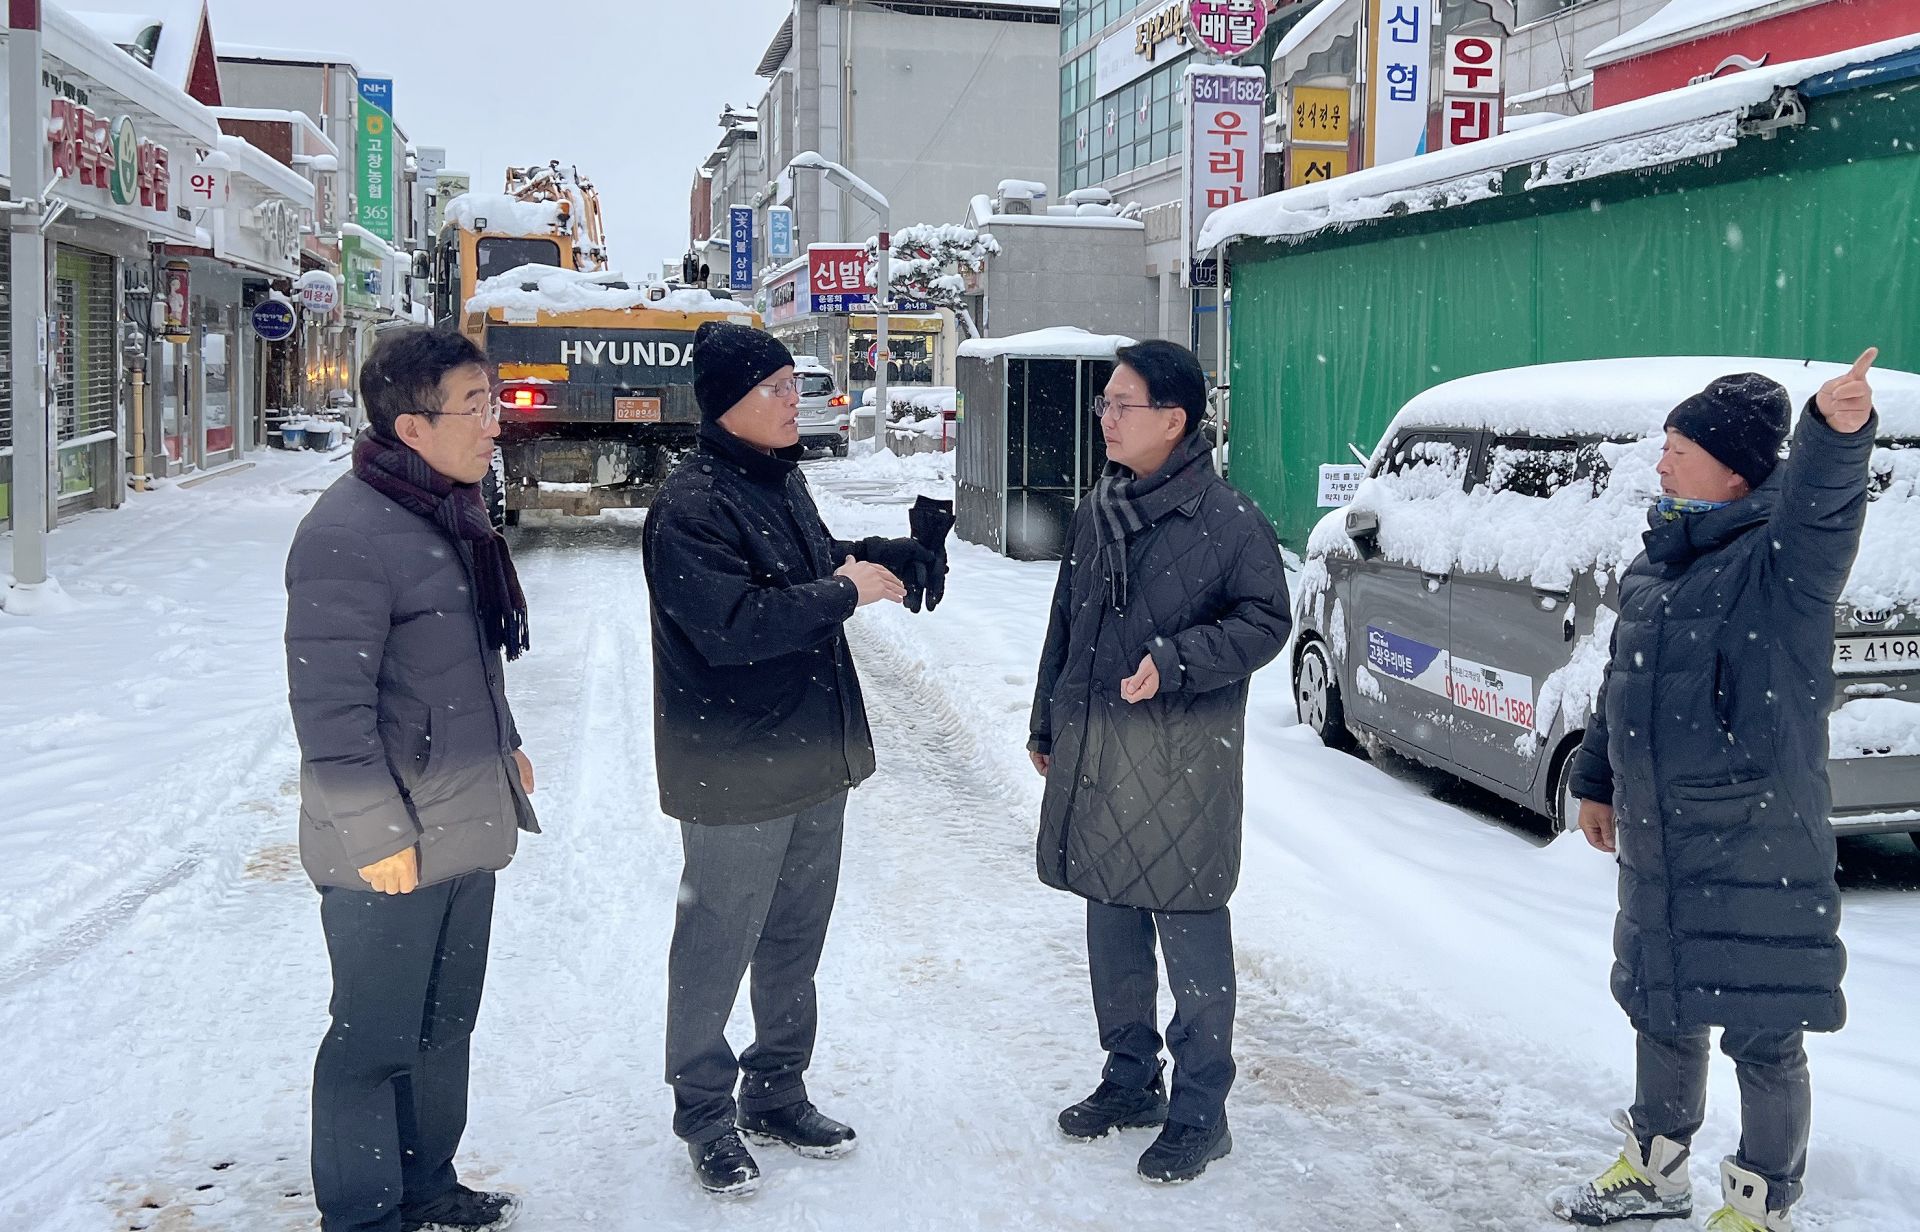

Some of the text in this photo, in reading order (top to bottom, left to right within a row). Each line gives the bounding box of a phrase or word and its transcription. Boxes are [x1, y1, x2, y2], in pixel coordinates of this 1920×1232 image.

[1200, 14, 1256, 45] 배달
[1387, 6, 1418, 102] 신협
[363, 84, 386, 93] NH
[1195, 78, 1263, 101] 561-1582
[1450, 38, 1493, 145] 우리
[1296, 102, 1341, 130] 일식전문
[367, 139, 383, 199] 고창농협
[191, 175, 215, 199] 약
[363, 205, 388, 219] 365
[736, 257, 748, 281] 상회
[304, 290, 333, 304] 미용실
[1369, 644, 1414, 674] 고창우리마트
[1864, 640, 1919, 662] 4198
[1445, 675, 1533, 727] 010-9611-1582
